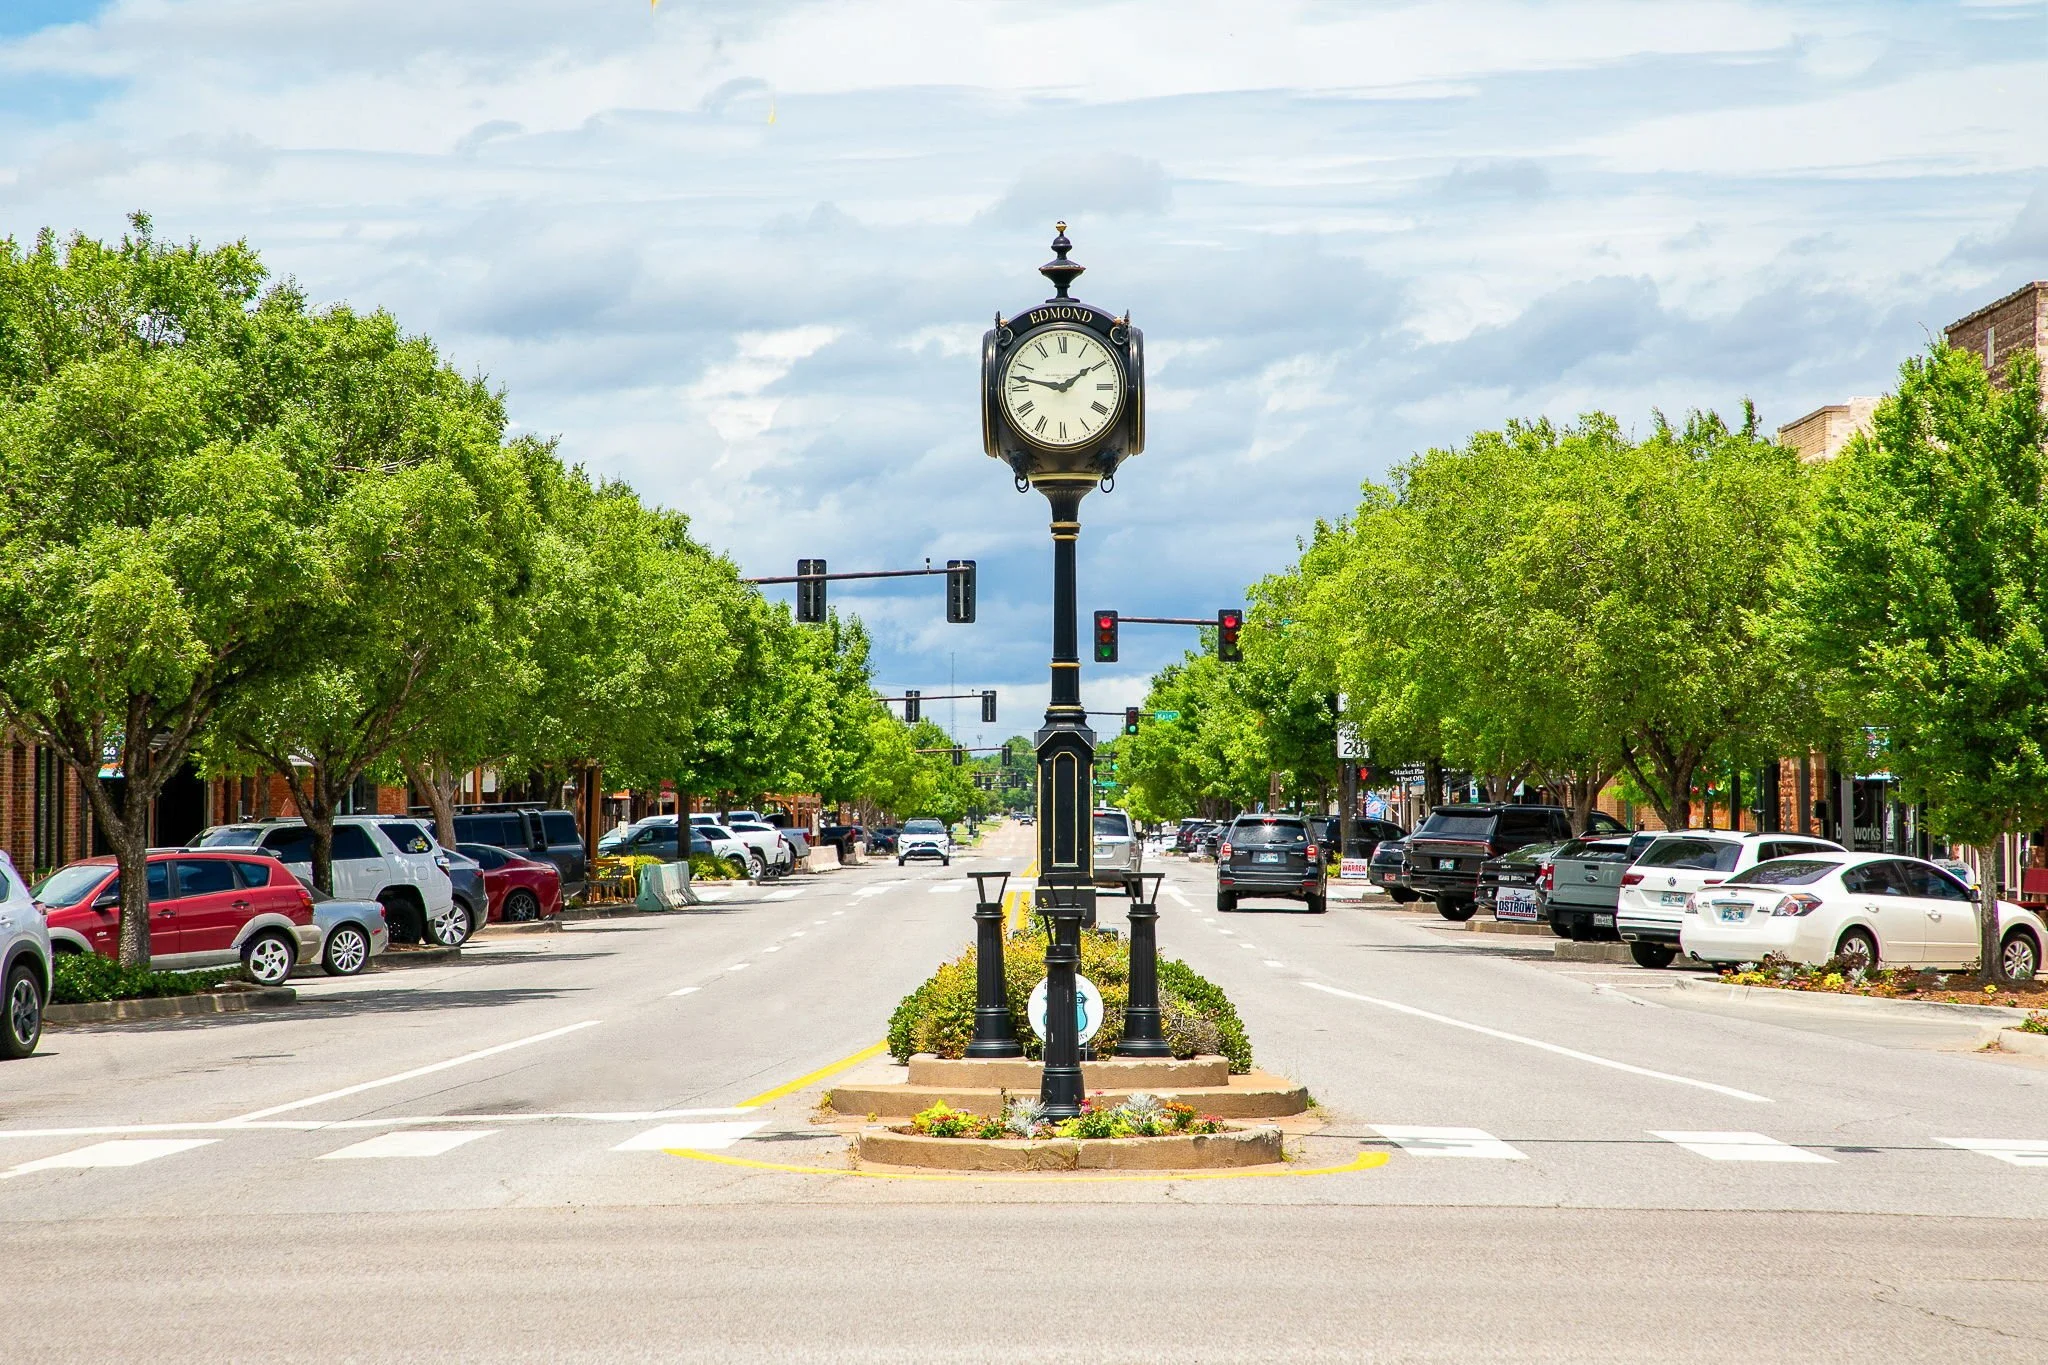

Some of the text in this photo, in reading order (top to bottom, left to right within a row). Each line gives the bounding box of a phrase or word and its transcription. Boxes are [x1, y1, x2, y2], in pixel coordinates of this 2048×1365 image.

[1030, 307, 1093, 324] EDMOND
[103, 746, 116, 756] 66
[1342, 864, 1366, 872] WARREN
